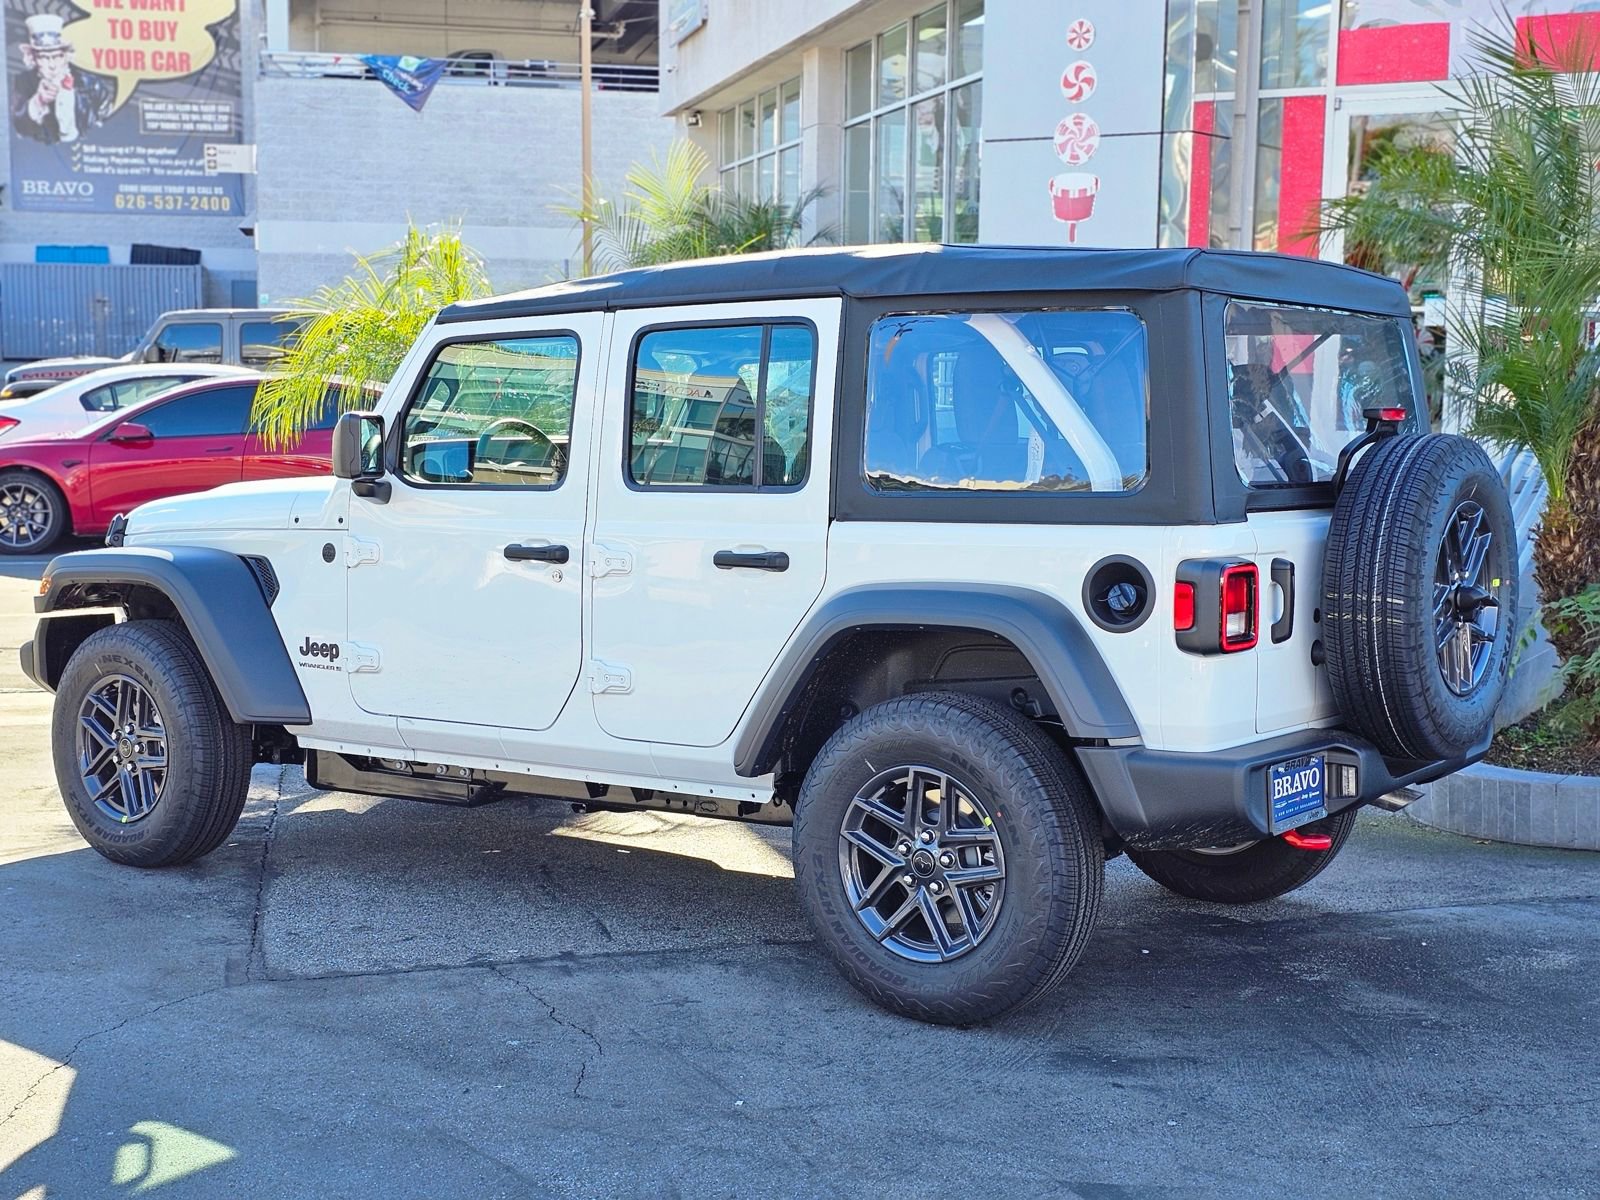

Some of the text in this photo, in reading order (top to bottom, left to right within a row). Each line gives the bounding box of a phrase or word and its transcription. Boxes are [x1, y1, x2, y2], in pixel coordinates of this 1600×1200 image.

[108, 18, 178, 42] TO BUY
[92, 48, 191, 72] YOUR CAR
[22, 180, 94, 196] BRAVO
[115, 194, 231, 211] 626-537-2400
[299, 636, 340, 662] Jeep
[101, 654, 154, 688] NEXEN
[299, 661, 335, 670] WRANGLER
[1274, 767, 1320, 799] BRAVO
